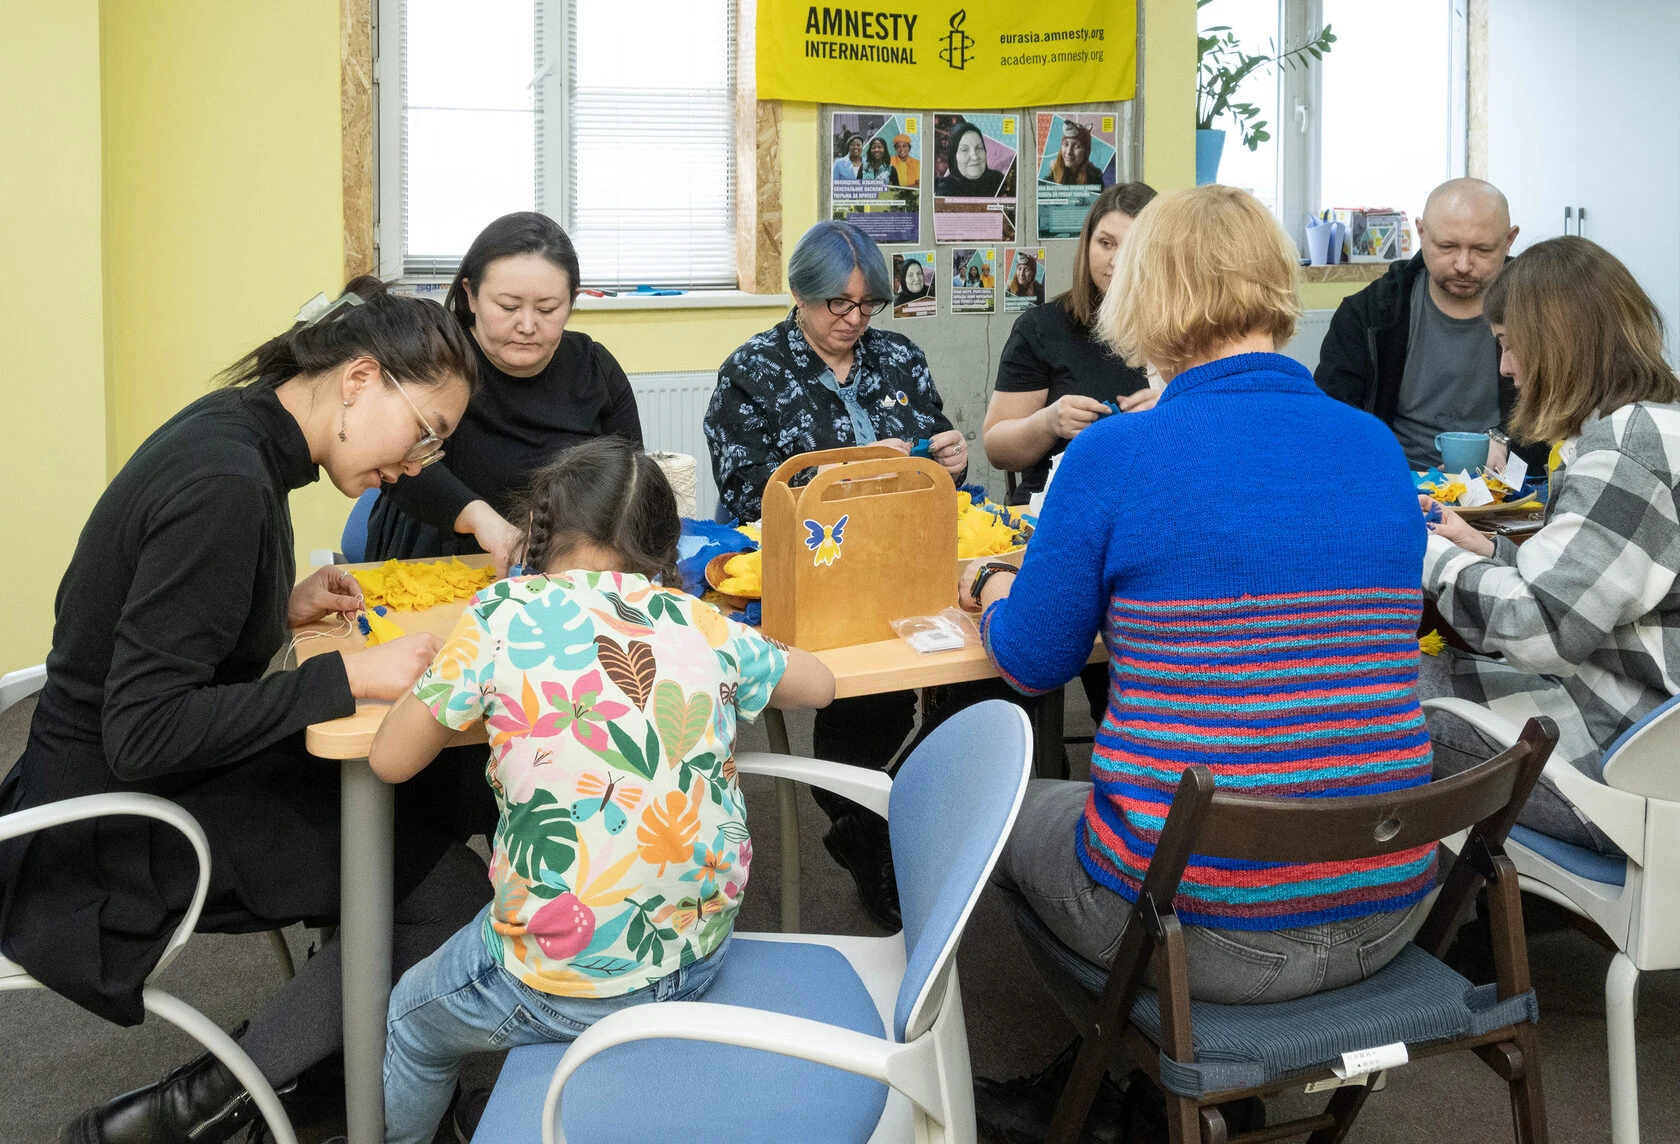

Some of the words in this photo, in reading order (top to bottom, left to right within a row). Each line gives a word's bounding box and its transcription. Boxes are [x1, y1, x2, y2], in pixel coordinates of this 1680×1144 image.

[805, 6, 918, 42] AMNESTY
[1000, 27, 1104, 44] eurasia.amnesty.org
[805, 40, 917, 64] INTERNATIONAL
[1000, 49, 1104, 66] academy.amnesty.org
